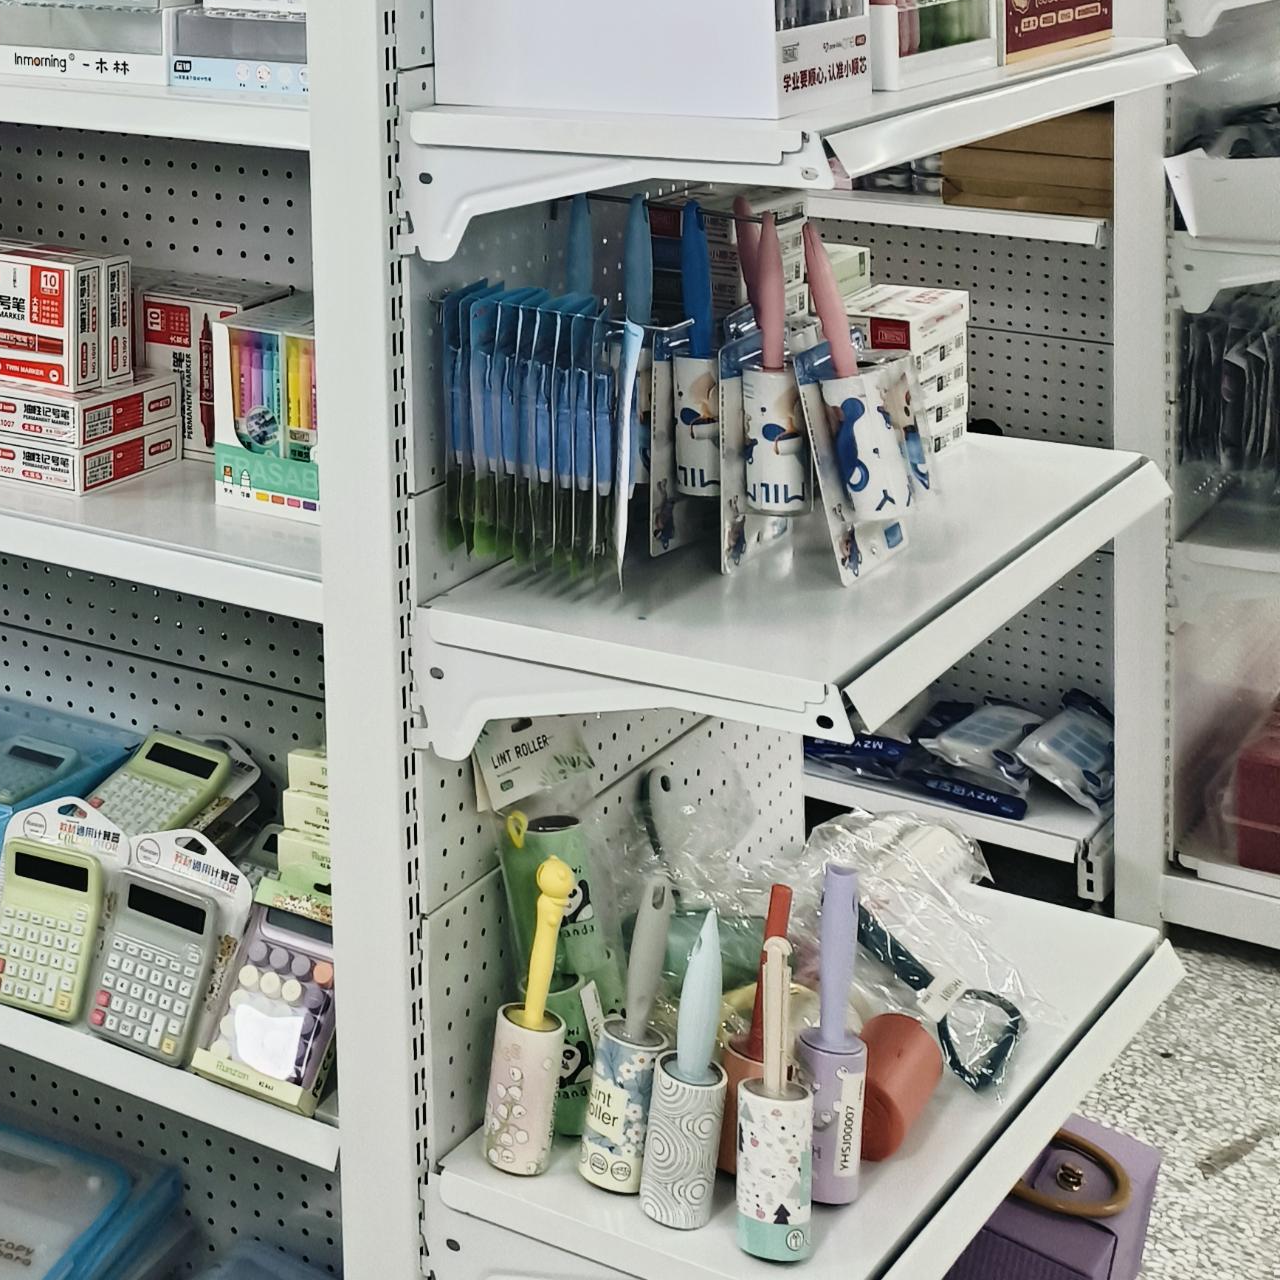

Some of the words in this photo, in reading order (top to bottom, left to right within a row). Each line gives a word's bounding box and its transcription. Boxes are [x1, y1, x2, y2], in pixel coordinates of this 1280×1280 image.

[14, 53, 67, 72] Inmorning
[42, 274, 57, 288] 10
[31, 297, 40, 322] 大双头
[149, 310, 160, 331] 10
[5, 362, 20, 373] TWIN
[21, 365, 45, 377] MARKER
[184, 352, 192, 388] MARKER
[23, 403, 70, 420] 油性记号笔
[184, 390, 194, 440] PERMANENT
[23, 450, 69, 468] 油性记号笔
[491, 749, 512, 769] LINT
[514, 734, 550, 759] ROLLER
[588, 1100, 620, 1127] oller
[840, 1105, 856, 1171] YHSJ0007
